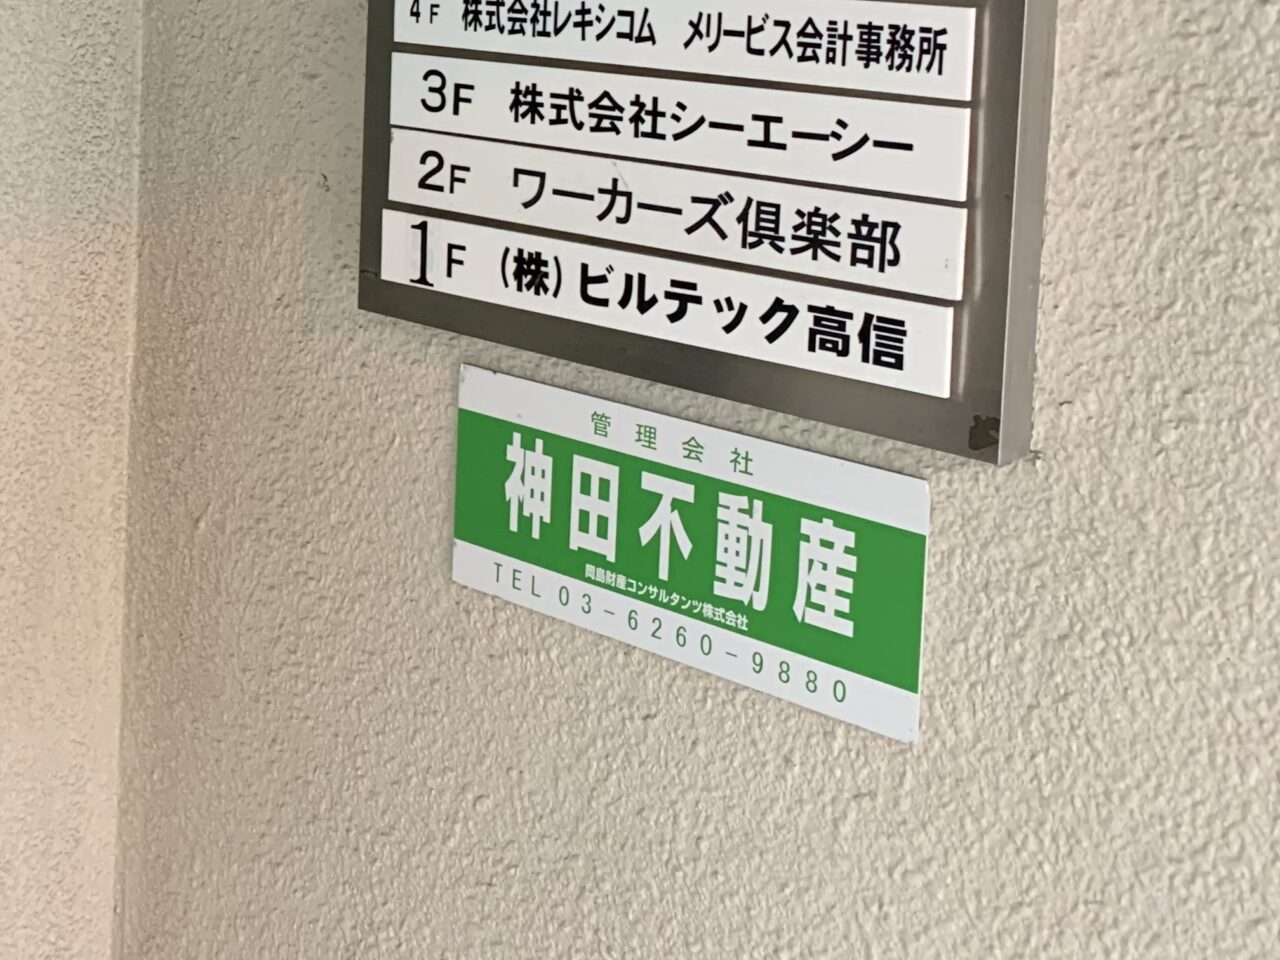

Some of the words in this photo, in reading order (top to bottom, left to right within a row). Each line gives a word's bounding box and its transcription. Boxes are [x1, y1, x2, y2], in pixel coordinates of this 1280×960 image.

[683, 11, 948, 76] メリービス会計事務所
[420, 69, 475, 116] 3F
[508, 80, 914, 161] 株式会社シーエーシー
[408, 220, 467, 289] 1F
[417, 149, 471, 195] 2F
[512, 167, 902, 274] ワーカーズ倶楽部
[591, 410, 754, 476] 管理会社
[505, 432, 857, 638] 神田不動産
[493, 562, 542, 598] TEL
[558, 585, 848, 703] 03-6260-9880
